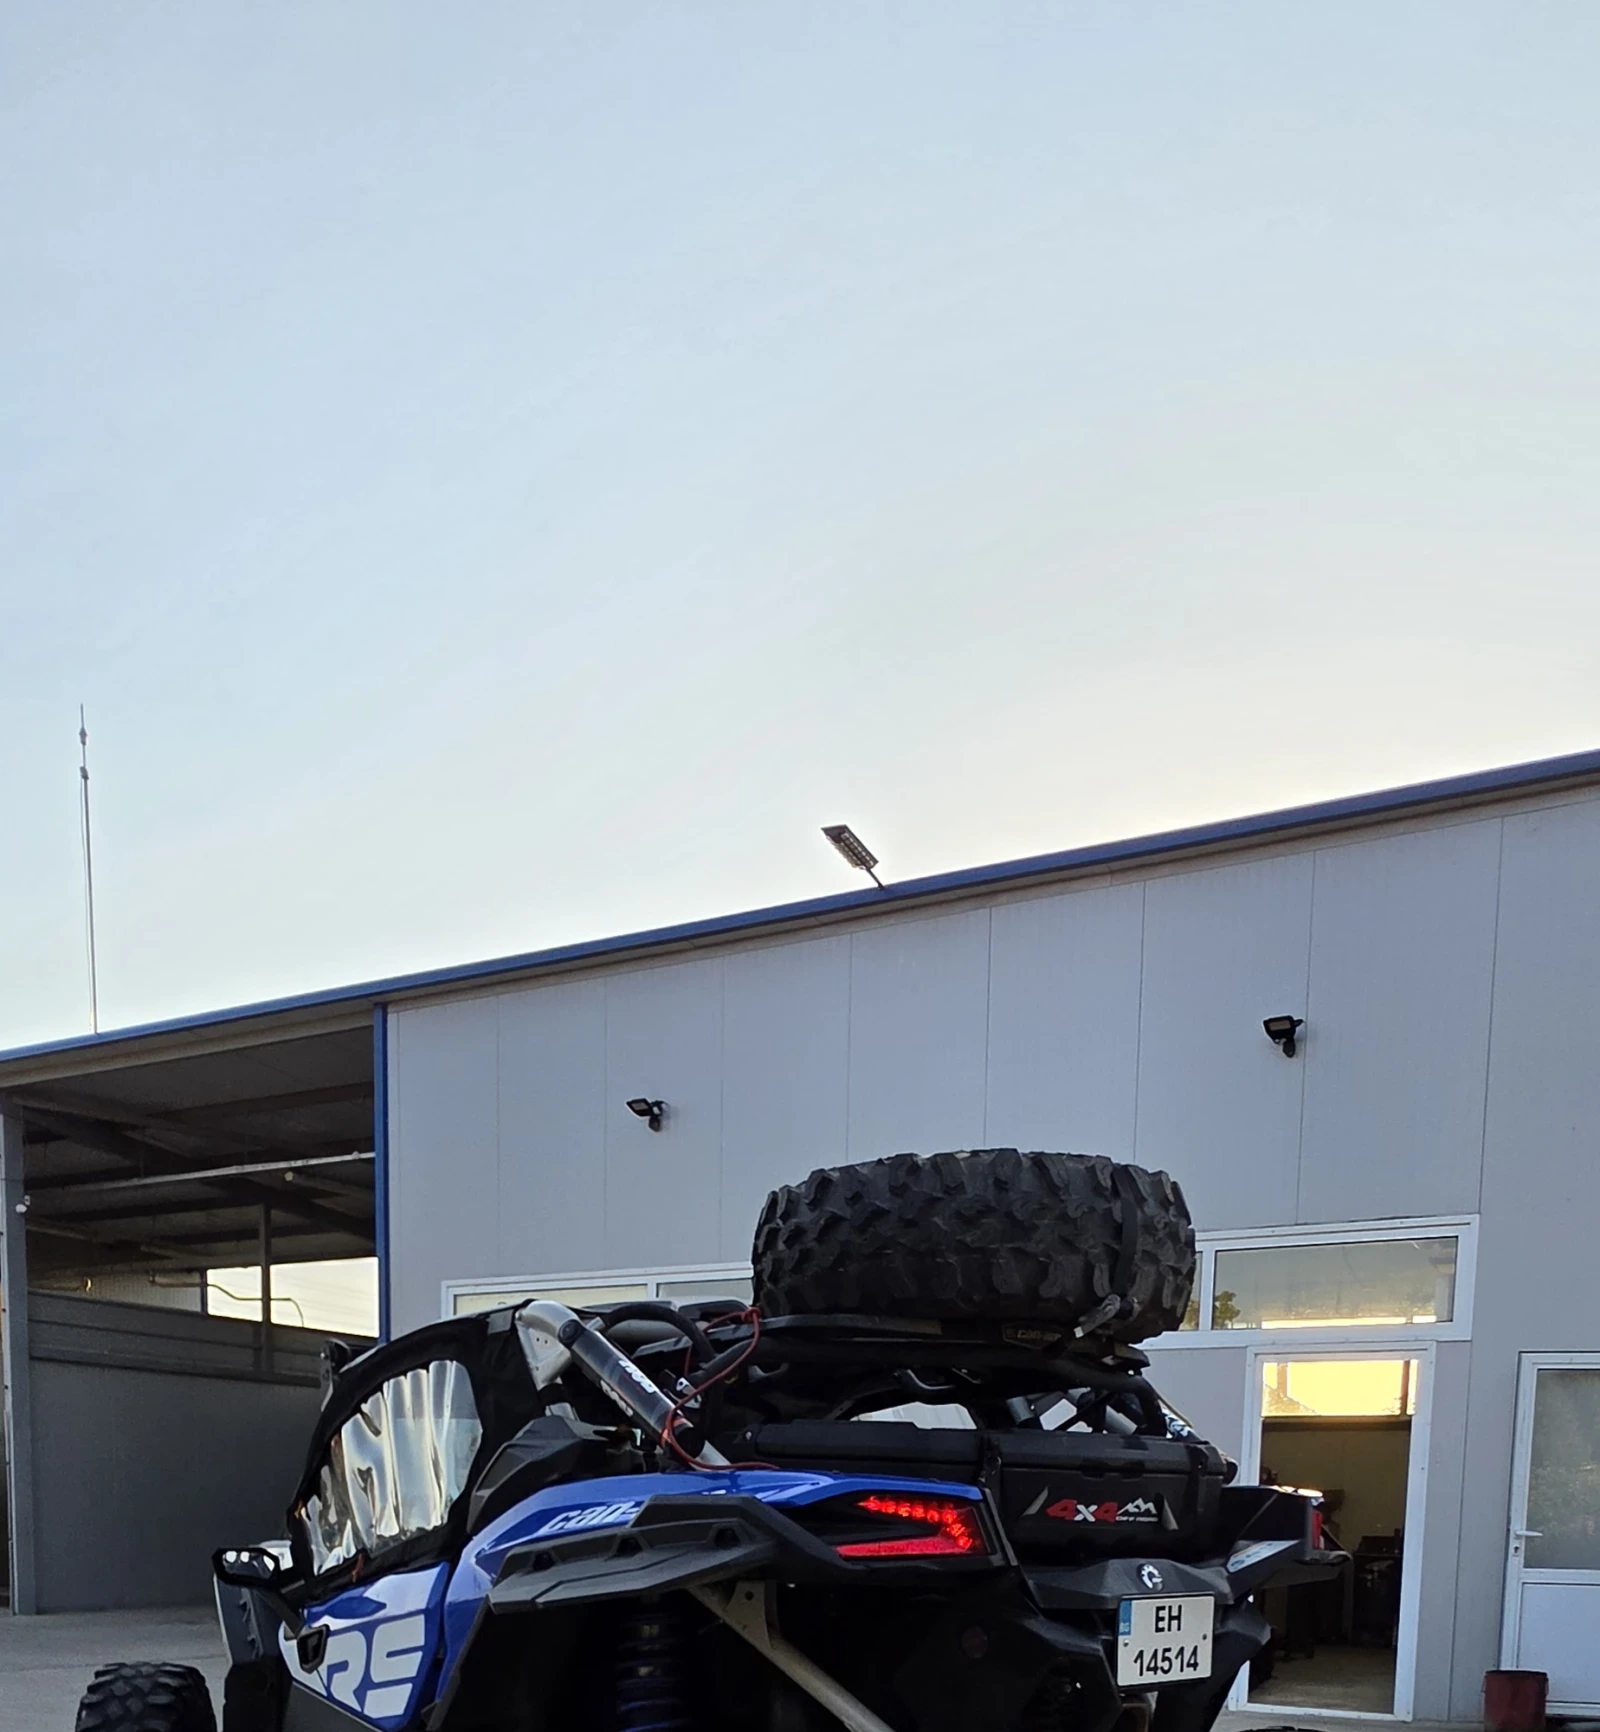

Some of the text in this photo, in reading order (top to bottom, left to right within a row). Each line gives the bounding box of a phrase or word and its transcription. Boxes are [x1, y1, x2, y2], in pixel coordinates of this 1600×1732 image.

[1045, 1498, 1118, 1523] 4x4
[1154, 1605, 1182, 1633] EH
[1133, 1645, 1199, 1677] 14514
